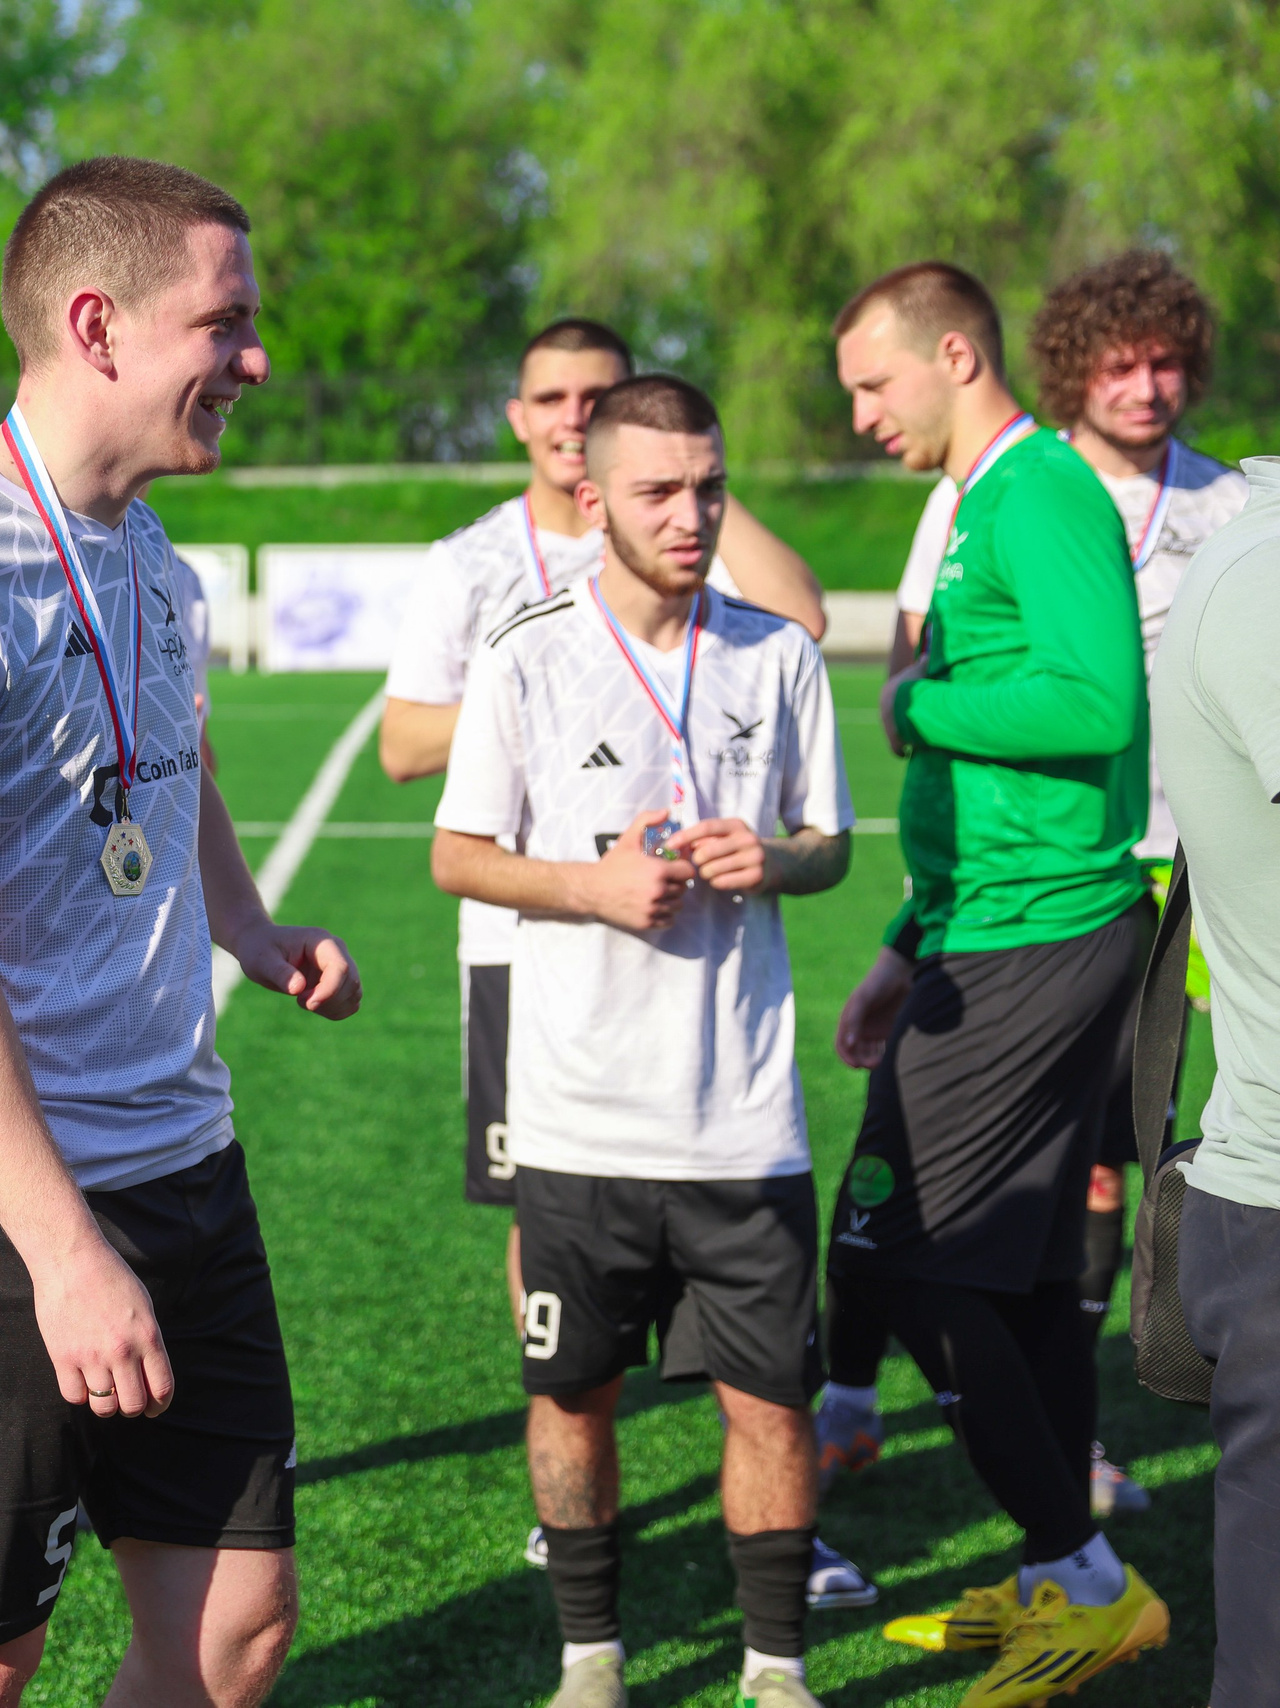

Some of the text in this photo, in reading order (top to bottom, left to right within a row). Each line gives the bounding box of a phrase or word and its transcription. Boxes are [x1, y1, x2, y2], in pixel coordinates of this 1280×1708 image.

[157, 632, 187, 661] ЧАЙ
[136, 746, 199, 783] Coin Tab
[485, 1121, 517, 1181] 9
[521, 1290, 562, 1360] 9
